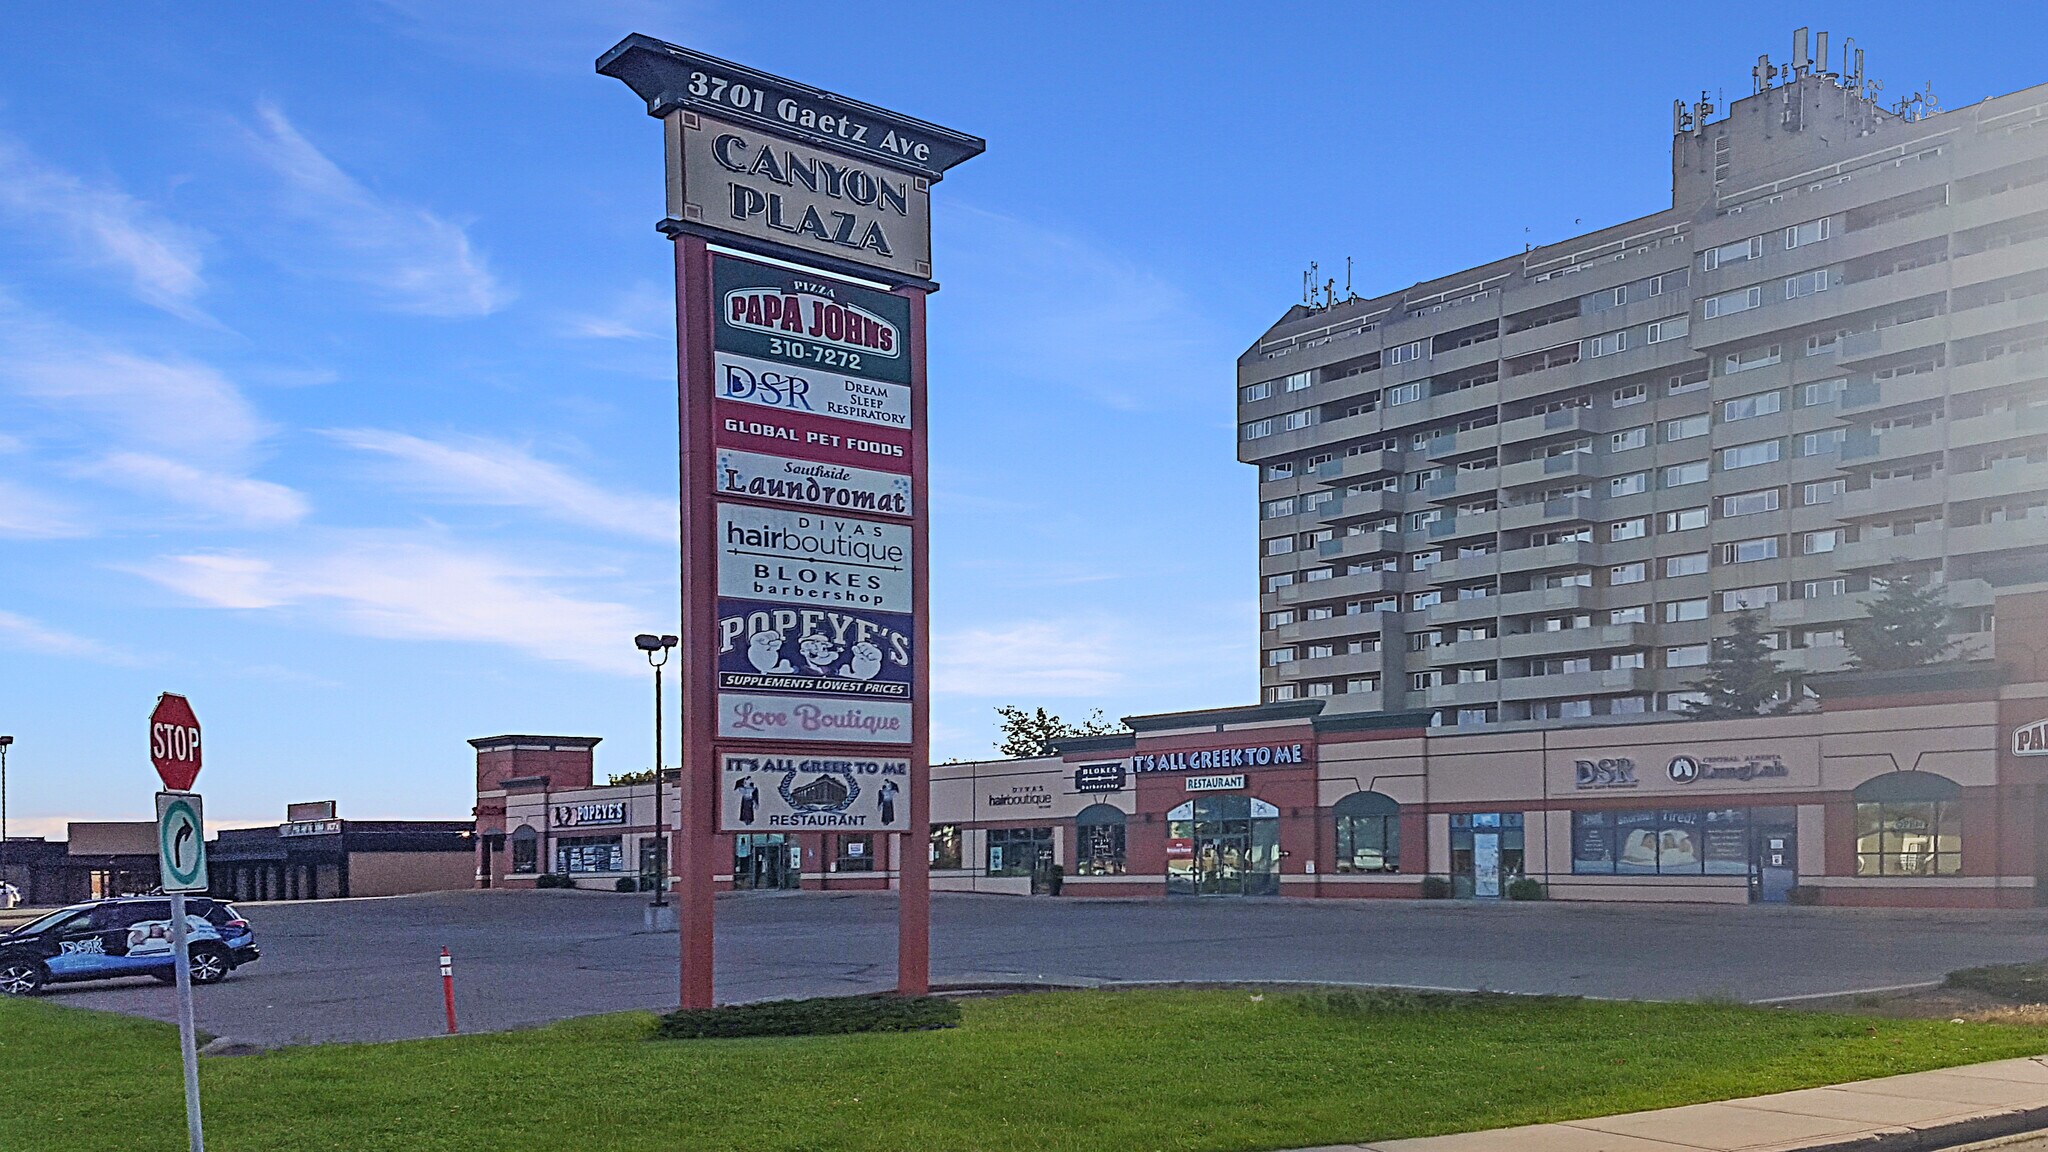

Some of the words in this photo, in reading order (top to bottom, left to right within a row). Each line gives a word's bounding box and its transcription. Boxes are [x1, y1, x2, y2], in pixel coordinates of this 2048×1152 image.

[688, 72, 764, 113] 3701
[777, 99, 868, 143] Gaetz
[880, 130, 930, 161] Ave
[712, 132, 908, 216] CANYON
[729, 182, 893, 256] PLAZA
[793, 281, 836, 298] PIZZA
[732, 294, 803, 334] PAPA
[770, 338, 861, 370] 310-7272
[722, 364, 814, 411] DSR
[844, 380, 888, 397] DREAM
[827, 401, 906, 424] RESPIRATORY
[850, 395, 883, 408] SLEEP
[725, 419, 799, 442] GLOBAL
[806, 431, 840, 447] PET
[847, 438, 903, 457] FOODS
[784, 462, 851, 481] Southside
[725, 469, 905, 513] Laundromat
[727, 521, 903, 562] hairboutique
[754, 564, 880, 590] BLOKES
[753, 582, 883, 605] barbershop
[718, 609, 908, 666] POPEYE'S
[726, 675, 813, 689] SUPPLEMENTS
[816, 680, 863, 692] LOWEST
[864, 683, 904, 694] PRICES
[732, 703, 787, 731] Love
[793, 704, 900, 735] Boutique
[153, 722, 199, 762] STOP
[2017, 724, 2048, 750] PA
[725, 757, 759, 771] IT'S
[762, 759, 797, 773] ALL
[799, 760, 853, 774] GREEK
[854, 762, 879, 775] TO
[882, 762, 906, 775] ME
[1083, 766, 1117, 775] BLOKES
[1129, 754, 1155, 773] IT'S
[1157, 752, 1186, 771] ALL
[1190, 748, 1243, 769] GREEK
[1246, 746, 1271, 766] TO
[1274, 744, 1302, 764] ME
[1575, 758, 1639, 784] DSR
[1187, 776, 1243, 789] RESTAURANT
[577, 803, 623, 821] POPEYE'S
[769, 815, 866, 826] RESTAURANT
